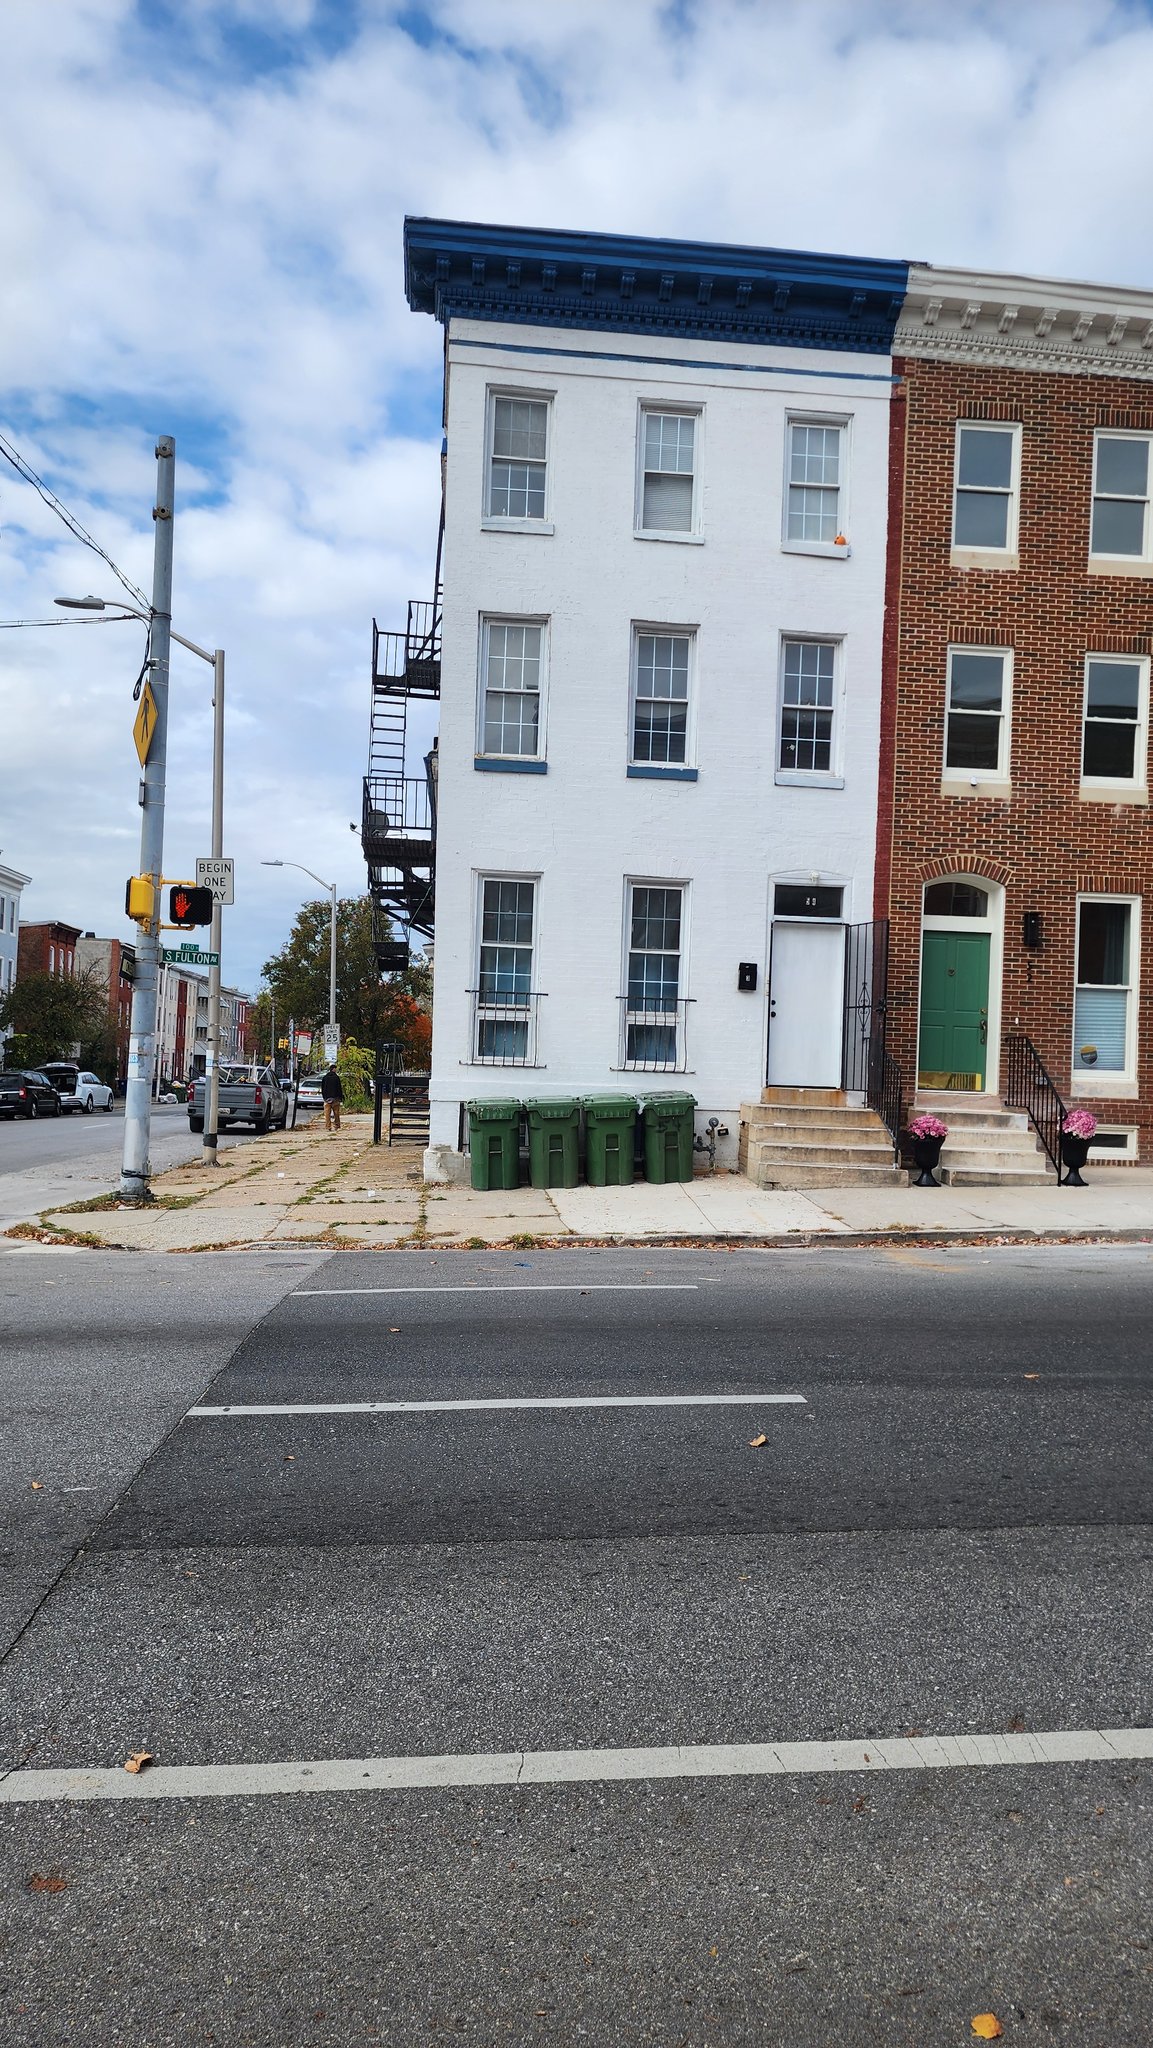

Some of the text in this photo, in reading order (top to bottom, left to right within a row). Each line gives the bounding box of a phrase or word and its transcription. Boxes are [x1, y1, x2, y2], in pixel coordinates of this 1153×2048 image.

[199, 863, 231, 873] BEGIN
[204, 877, 226, 887] ONE
[212, 891, 226, 900] AY
[165, 950, 172, 961] S
[175, 951, 209, 964] FULTON
[326, 1034, 338, 1042] 25
